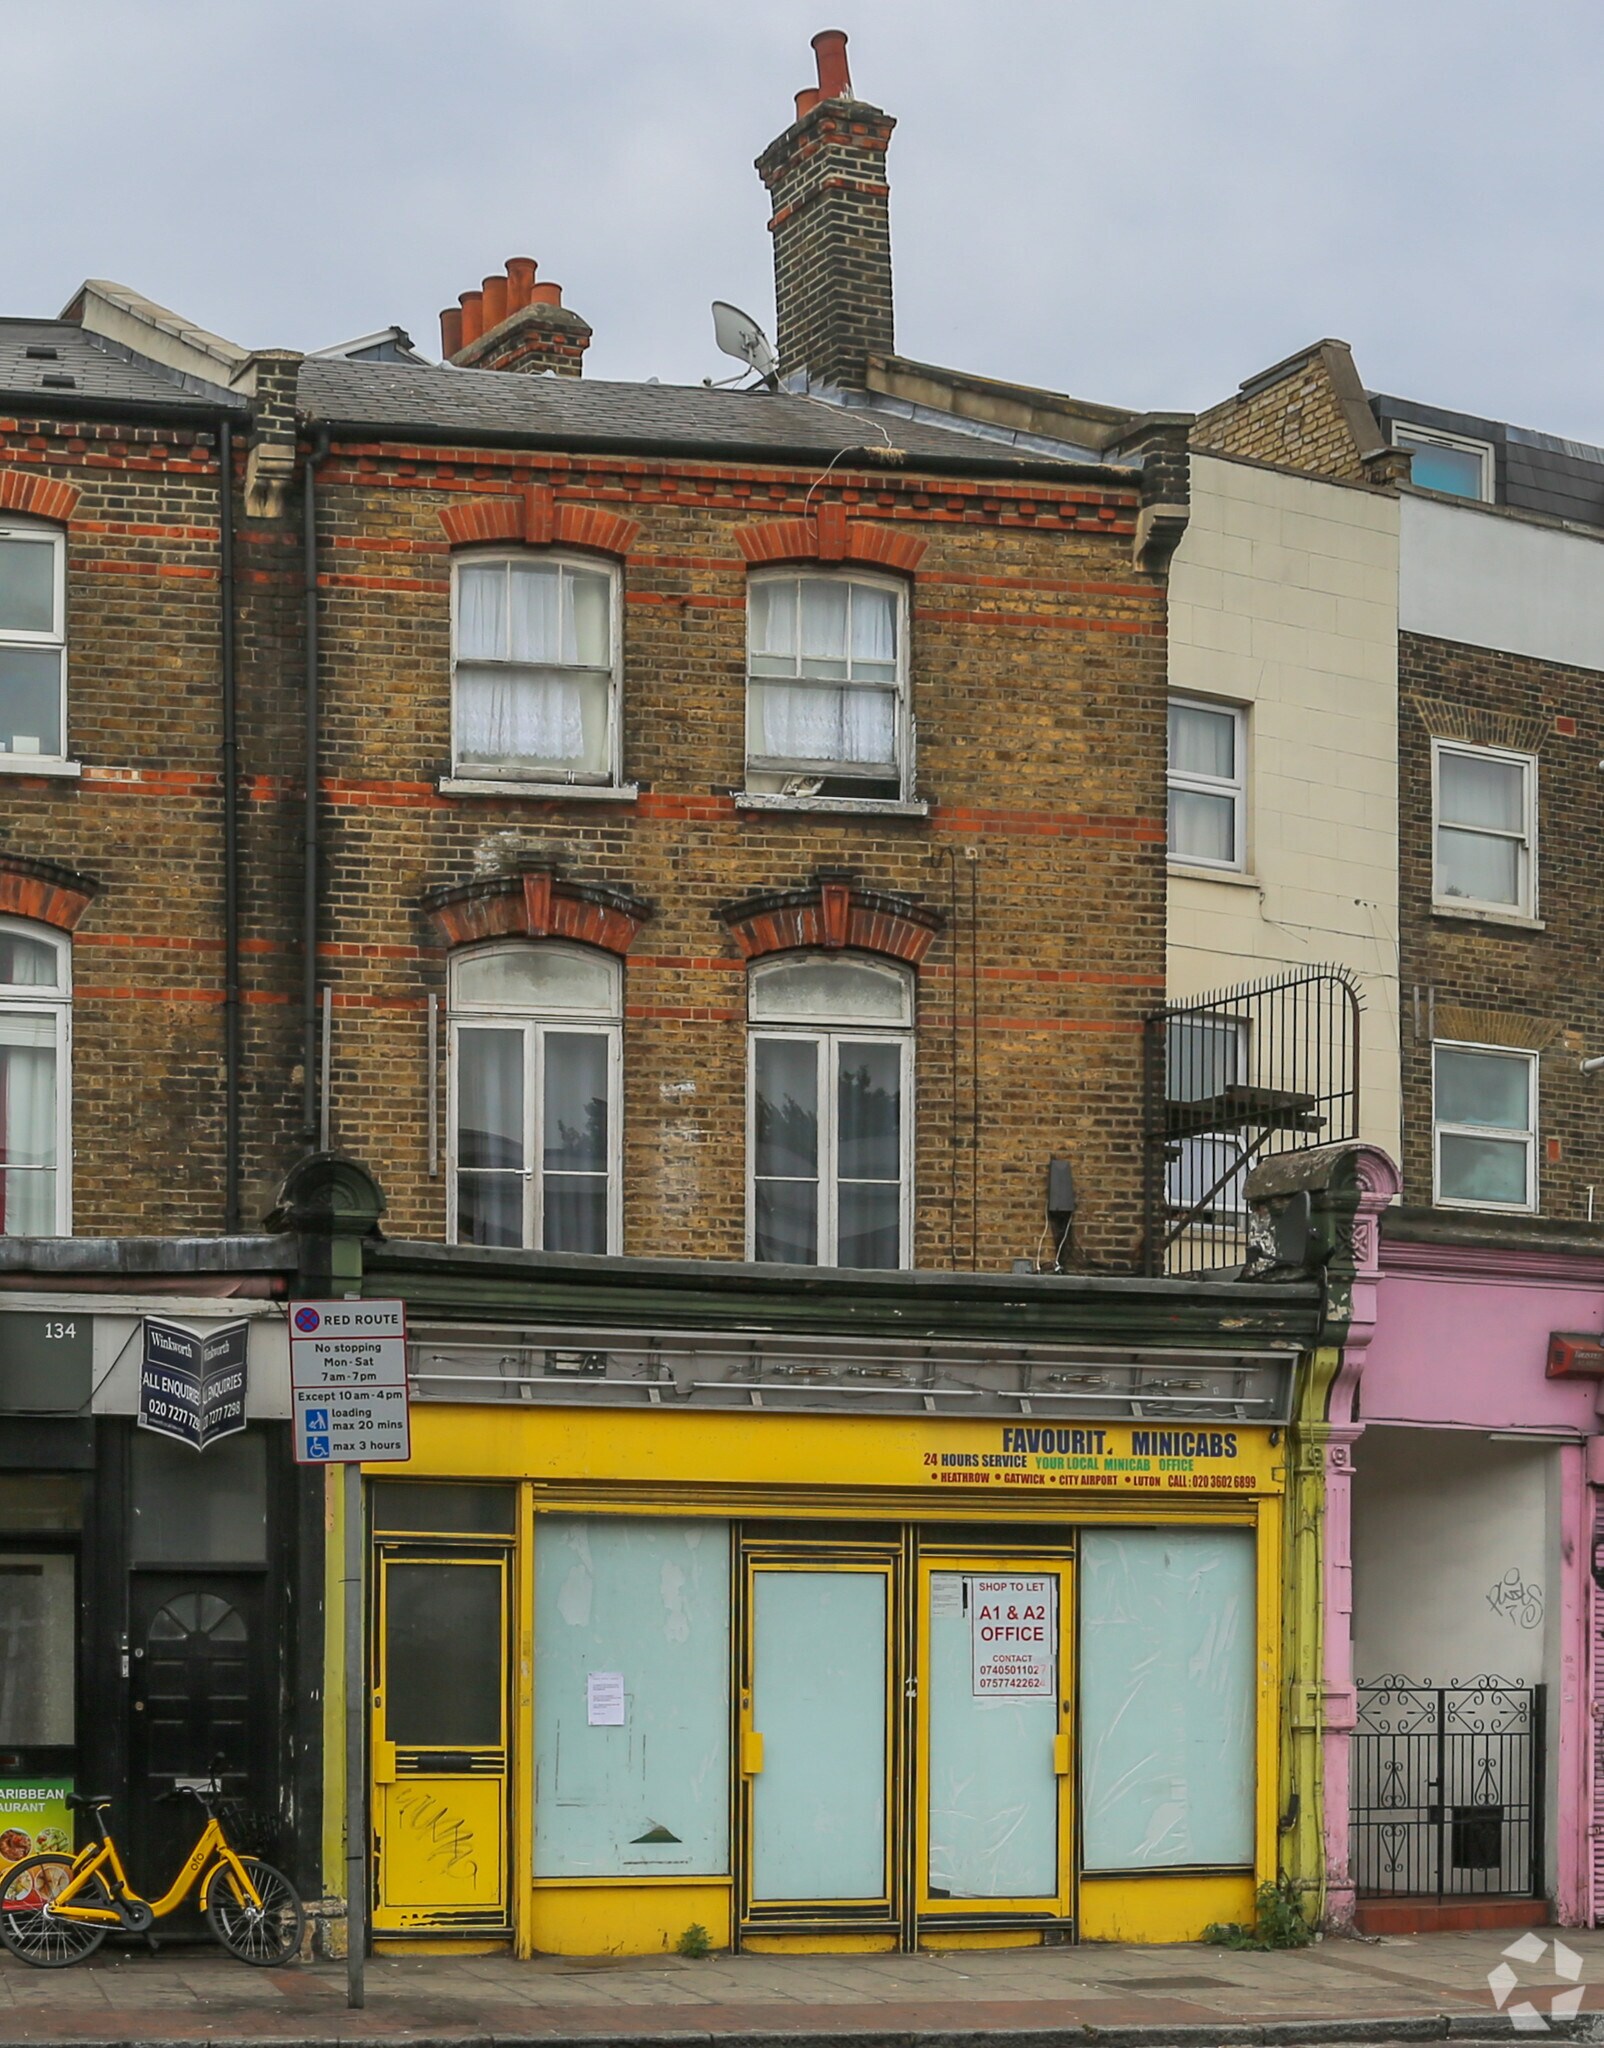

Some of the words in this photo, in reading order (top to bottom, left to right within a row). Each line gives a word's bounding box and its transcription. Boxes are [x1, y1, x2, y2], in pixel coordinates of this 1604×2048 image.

[324, 1315, 350, 1325] RED
[355, 1314, 399, 1325] ROUTE
[45, 1322, 76, 1339] 134
[151, 1331, 192, 1358] Winkworth
[315, 1343, 331, 1353] No
[334, 1343, 382, 1354] stopping
[142, 1372, 160, 1390] ALL
[298, 1391, 336, 1402] Except
[148, 1399, 166, 1416] 020
[168, 1405, 188, 1424] 7277
[332, 1408, 372, 1418] loading
[332, 1422, 355, 1430] max
[358, 1420, 374, 1430] 20
[378, 1420, 403, 1429] mins
[333, 1443, 356, 1451] max
[359, 1441, 366, 1451] 3
[370, 1441, 402, 1450] hours
[1003, 1428, 1112, 1455] FAVOURIT
[1132, 1431, 1237, 1458] MINICABS
[923, 1453, 938, 1466] 24
[941, 1453, 979, 1467] HOURS
[982, 1454, 1027, 1468] SERVICE
[1036, 1456, 1064, 1470] YOUR
[1067, 1457, 1099, 1470] LOCAL
[1104, 1458, 1150, 1471] MINICAB
[1159, 1458, 1194, 1472] OFFICE
[941, 1472, 990, 1483] HEATHROW
[1004, 1473, 1045, 1484] GATWICK
[1059, 1474, 1079, 1485] CITY
[1081, 1475, 1118, 1486] AIRPORT
[1134, 1475, 1160, 1487] LUTON
[1210, 1475, 1232, 1488] 3602
[1234, 1476, 1256, 1489] 6899
[979, 1583, 1007, 1592] SHOP
[1010, 1583, 1024, 1592] TO
[1026, 1582, 1045, 1592] LET
[979, 1606, 1000, 1620] A1
[1007, 1606, 1019, 1620] &
[1023, 1606, 1045, 1620] A2
[981, 1627, 1044, 1641] OFFICE
[190, 1852, 205, 1872] ofo
